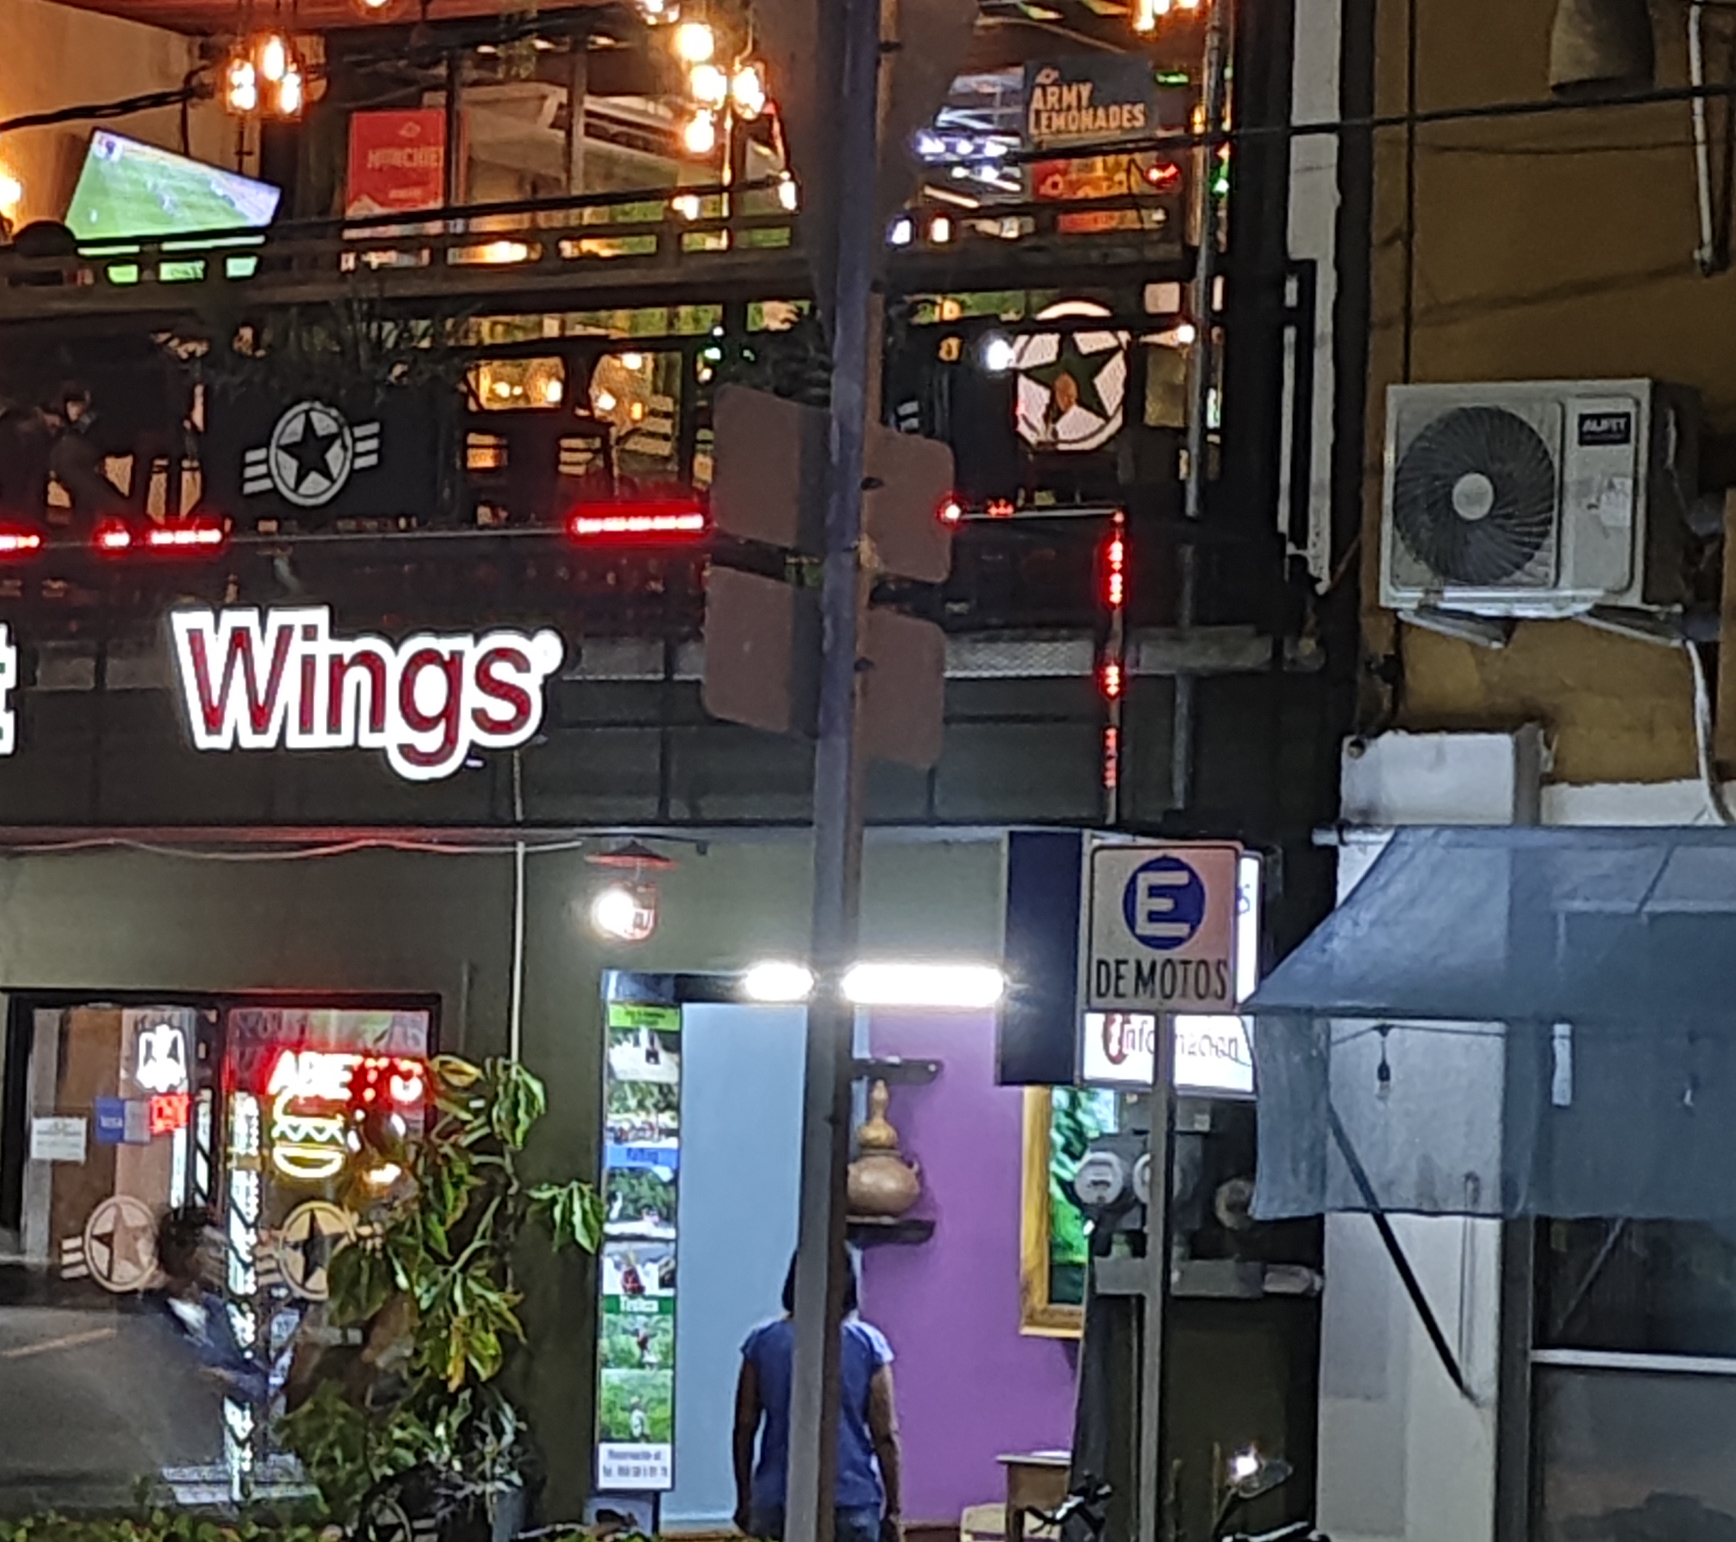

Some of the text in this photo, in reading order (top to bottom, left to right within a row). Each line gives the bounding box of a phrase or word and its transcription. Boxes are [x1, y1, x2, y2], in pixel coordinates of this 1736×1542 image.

[1030, 82, 1093, 111] ARMY
[1028, 102, 1146, 136] LEMONADES
[173, 605, 563, 781] Wings
[1135, 870, 1191, 937] E
[1095, 958, 1229, 1001] DE MOTOS
